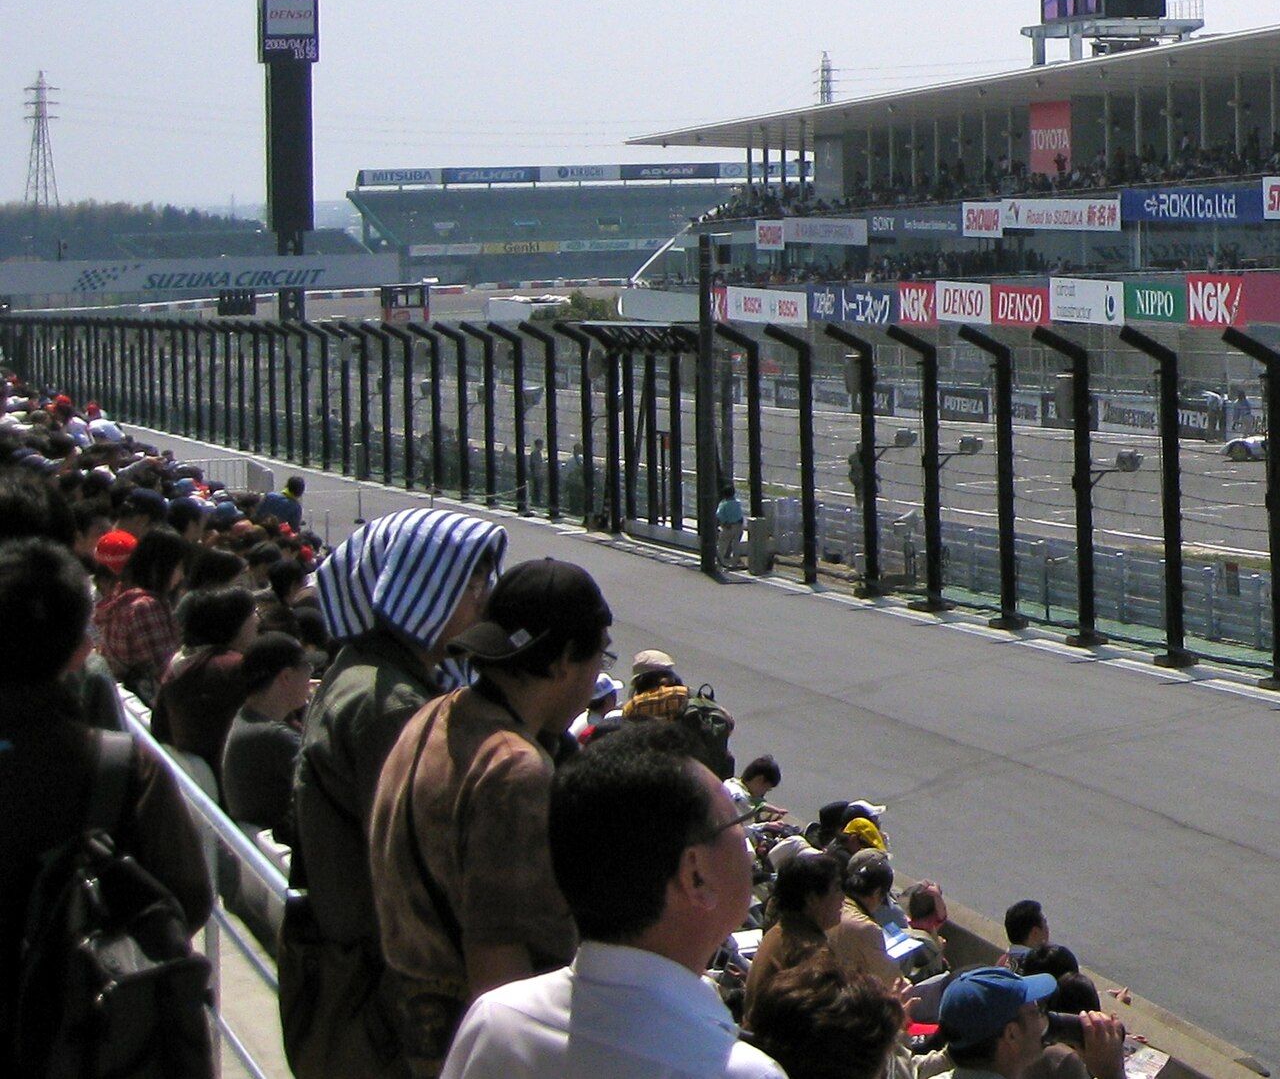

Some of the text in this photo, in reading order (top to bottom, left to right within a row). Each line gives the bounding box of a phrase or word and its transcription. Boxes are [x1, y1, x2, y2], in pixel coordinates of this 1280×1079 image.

[269, 9, 312, 19] DENSO
[1031, 128, 1070, 150] TOYOTA
[372, 170, 433, 182] MITSUBA
[458, 169, 525, 181] FALKEN
[639, 167, 694, 176] ADVAN
[1159, 193, 1196, 218] ROKI
[872, 216, 895, 231] SONY
[966, 208, 1000, 231] SHOWA
[1026, 209, 1046, 224] Road
[1054, 209, 1084, 225] SUZUKA
[503, 241, 540, 253] Genki
[143, 268, 326, 290] SUZUKA CIRCUIT
[743, 296, 763, 314] BOSCH
[778, 299, 798, 318] BOSCH
[841, 288, 890, 324] トーエネック
[900, 288, 928, 322] NGK
[942, 287, 983, 318] DENSO
[998, 291, 1042, 323] DENSO
[1135, 289, 1174, 318] NIPPO
[1187, 280, 1231, 325] NGK
[943, 396, 986, 415] POTENZA
